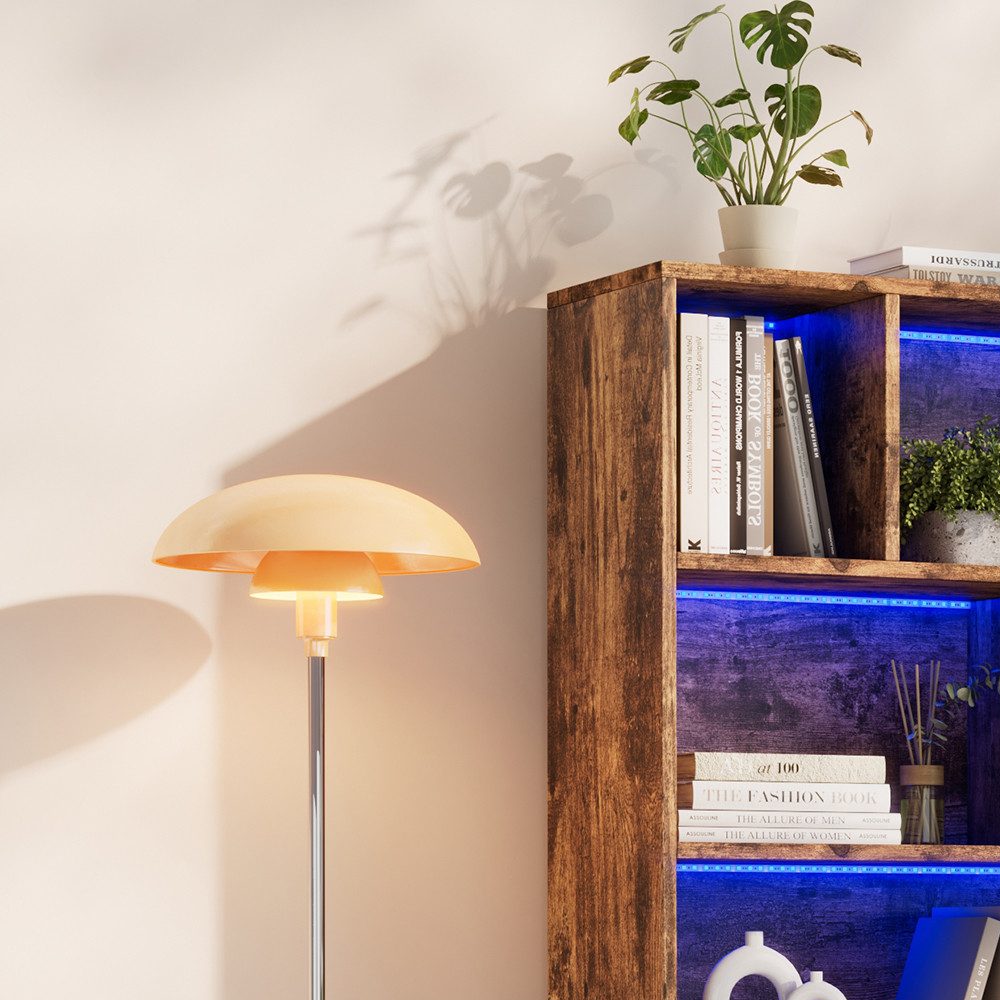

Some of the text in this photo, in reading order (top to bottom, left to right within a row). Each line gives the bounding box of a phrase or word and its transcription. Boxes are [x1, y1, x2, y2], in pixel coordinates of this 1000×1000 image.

[912, 269, 951, 282] TOLSTOY
[957, 274, 997, 286] WAR
[757, 762, 799, 774] at 100
[703, 789, 878, 804] THE FASHION BOOK
[736, 815, 845, 824] THE ALLURE OF MEN
[724, 831, 851, 840] THE ALLURE OF WOMEN
[977, 957, 988, 976] LES
